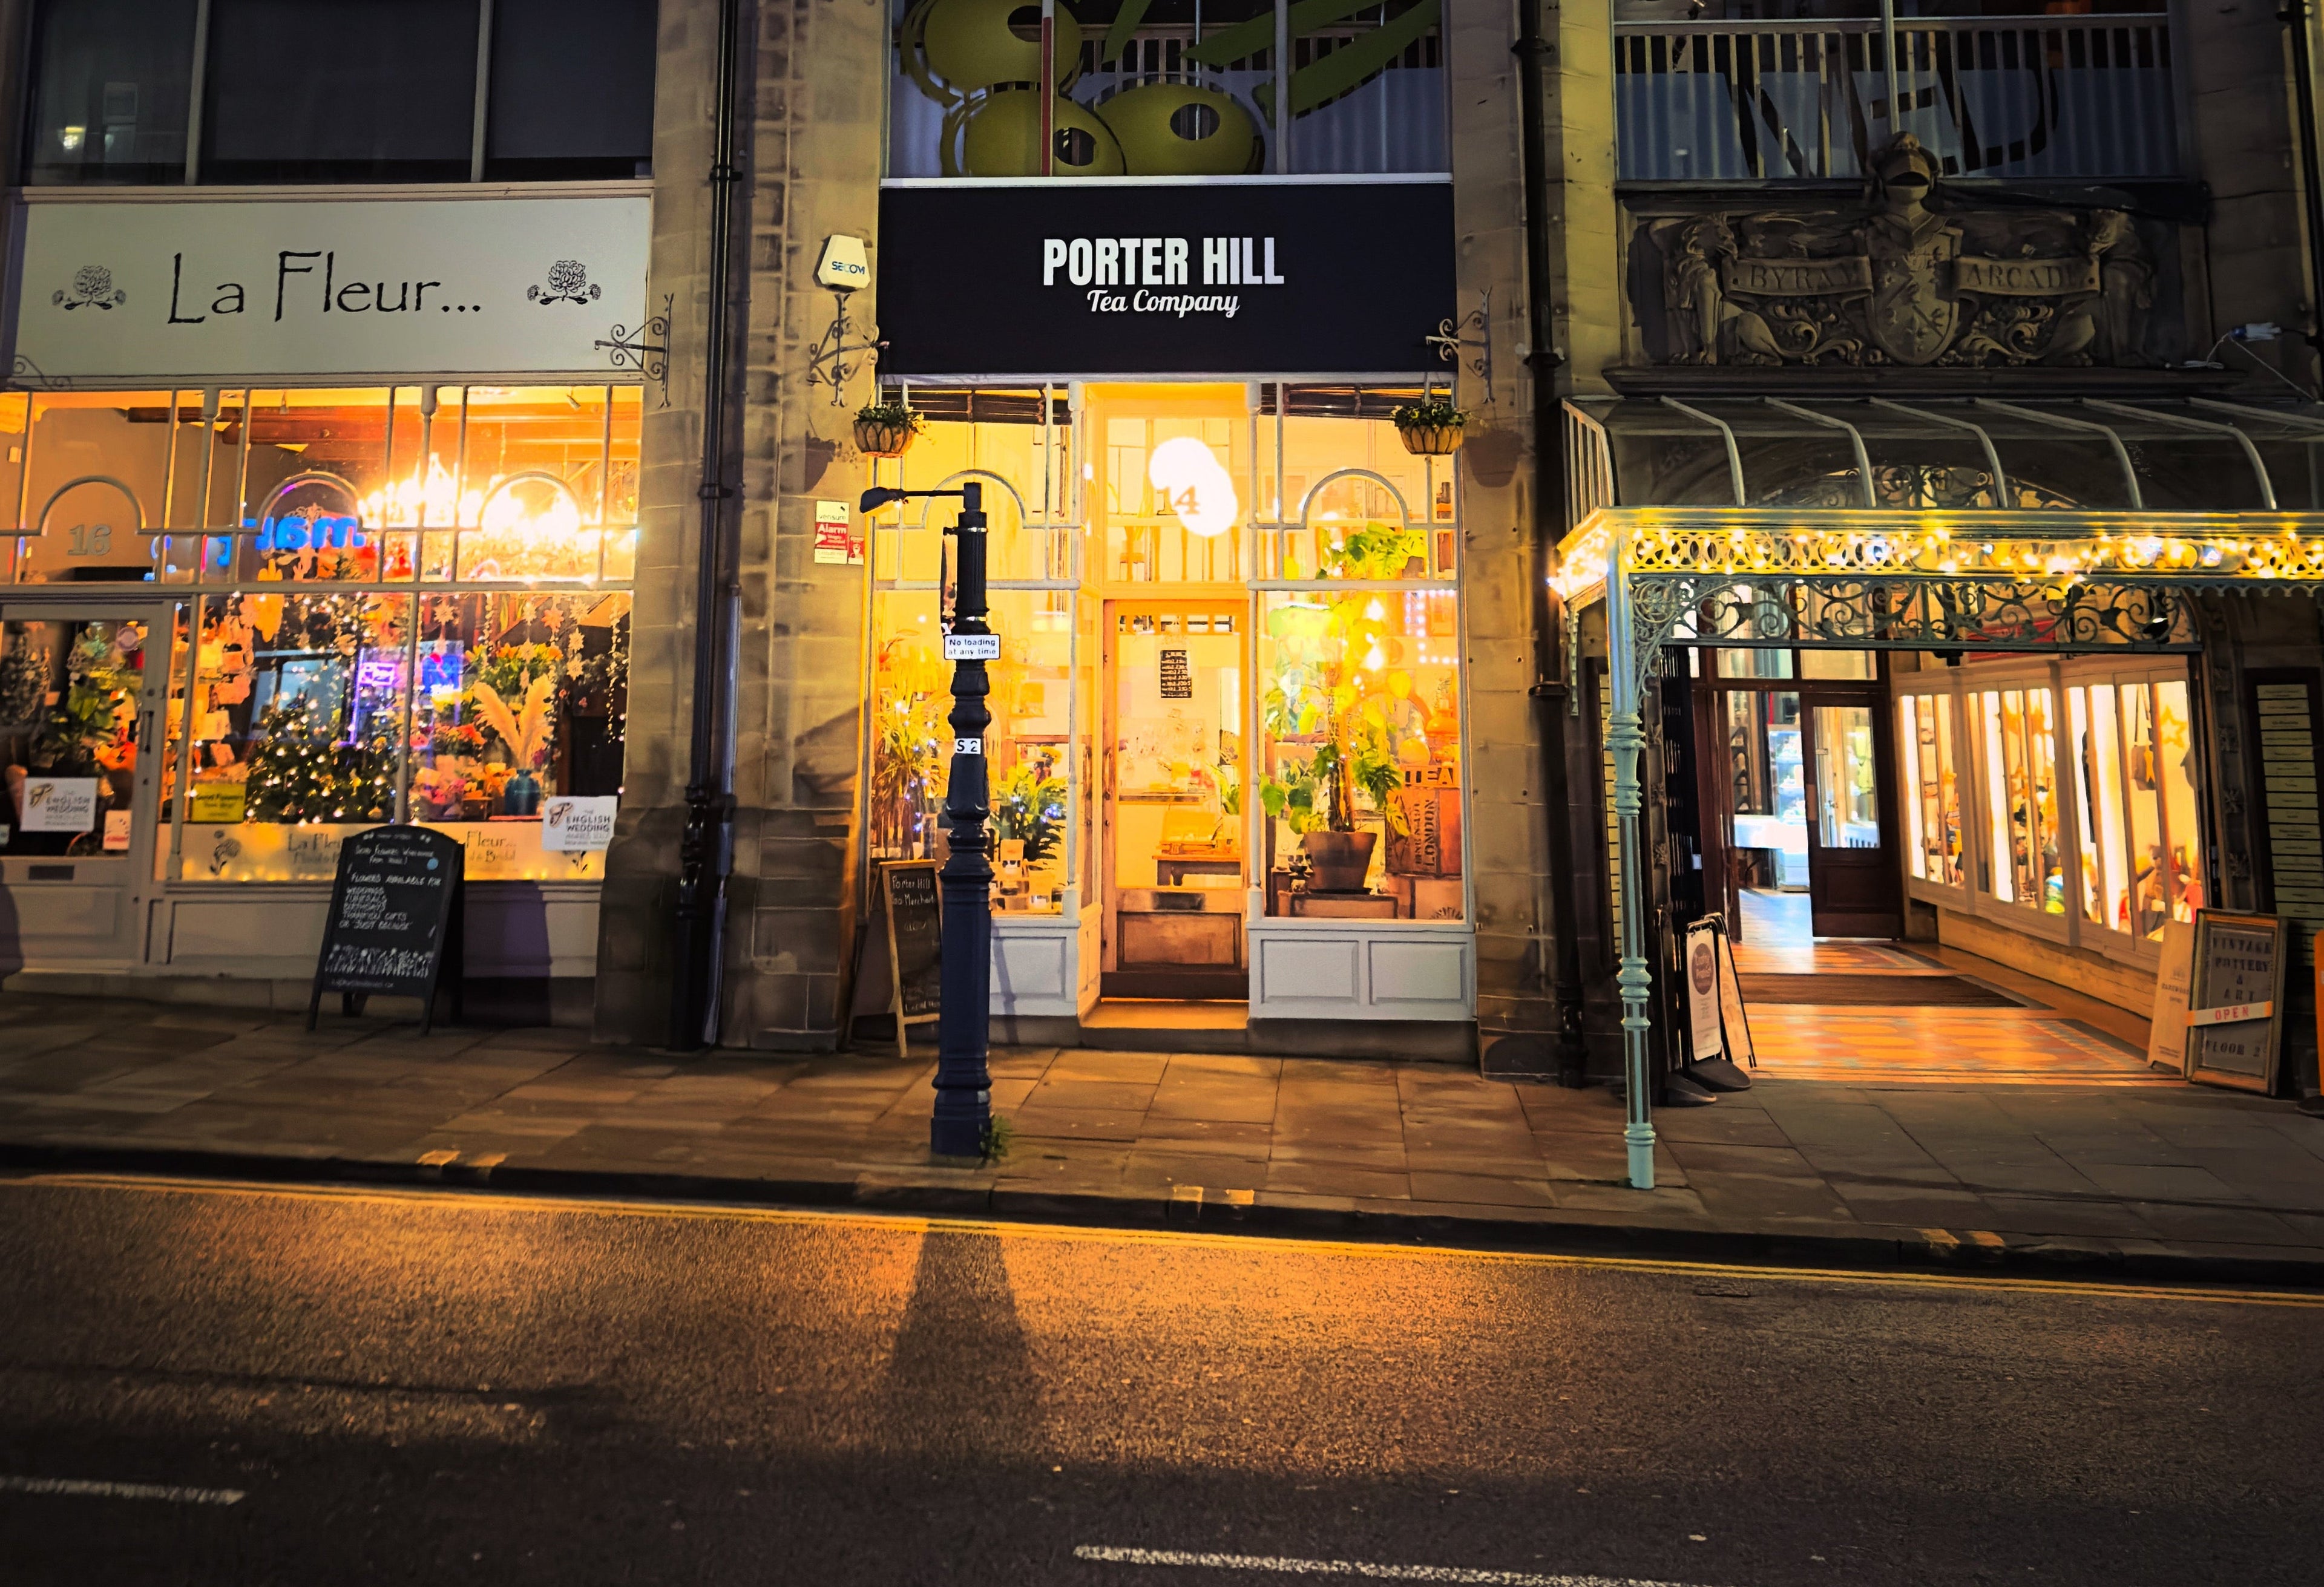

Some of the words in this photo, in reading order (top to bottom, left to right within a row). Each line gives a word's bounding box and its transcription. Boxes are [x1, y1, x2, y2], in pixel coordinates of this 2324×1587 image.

[832, 261, 865, 274] SECOM
[1043, 238, 1189, 286] PORTER
[1203, 237, 1284, 284] HILL
[168, 252, 245, 324] La
[1087, 290, 1130, 312] Tea
[1132, 289, 1240, 318] Company
[1157, 485, 1200, 515] 14
[817, 523, 847, 534] Alarm
[68, 523, 112, 556] 16
[965, 638, 996, 647] loading
[957, 739, 965, 752] S
[971, 740, 978, 752] 2
[1404, 767, 1454, 787] TEA
[566, 815, 611, 823] ENGLISH
[567, 823, 610, 833] WEDDING
[1423, 799, 1436, 867] LONDON
[891, 875, 915, 889] Porter
[917, 877, 930, 889] Hill
[2213, 937, 2271, 954] VINTAGE
[2215, 957, 2269, 972] POTTERY
[2224, 989, 2255, 1001] ART
[2214, 1006, 2250, 1021] OPEN
[2206, 1040, 2245, 1056] FLOOR
